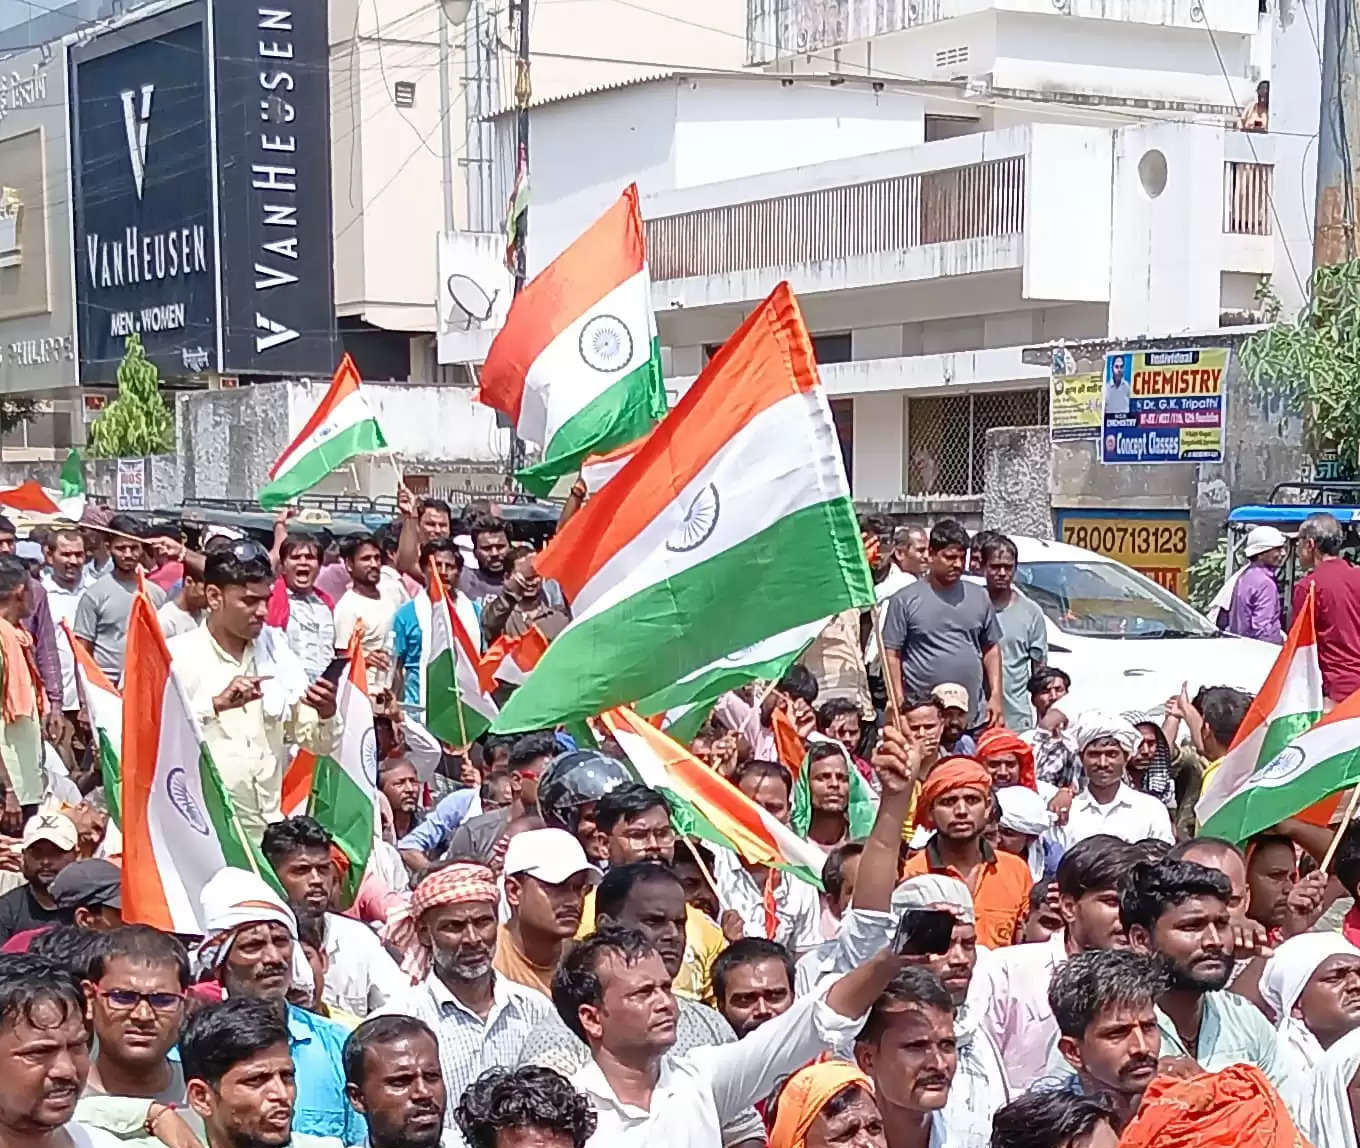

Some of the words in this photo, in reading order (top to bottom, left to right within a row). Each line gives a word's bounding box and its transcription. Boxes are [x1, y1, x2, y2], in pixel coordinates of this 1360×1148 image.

[110, 311, 134, 337] MEN
[140, 303, 186, 333] WOMEN
[7, 335, 74, 367] PHILIPPE
[1132, 368, 1222, 396] CHEMISTRY
[1143, 399, 1157, 410] Dr.
[1158, 398, 1179, 410] G.K.
[1181, 397, 1218, 412] Tripathi
[1116, 432, 1147, 460] Concept
[1148, 431, 1179, 455] Classes
[1063, 525, 1187, 554] 7800713123
